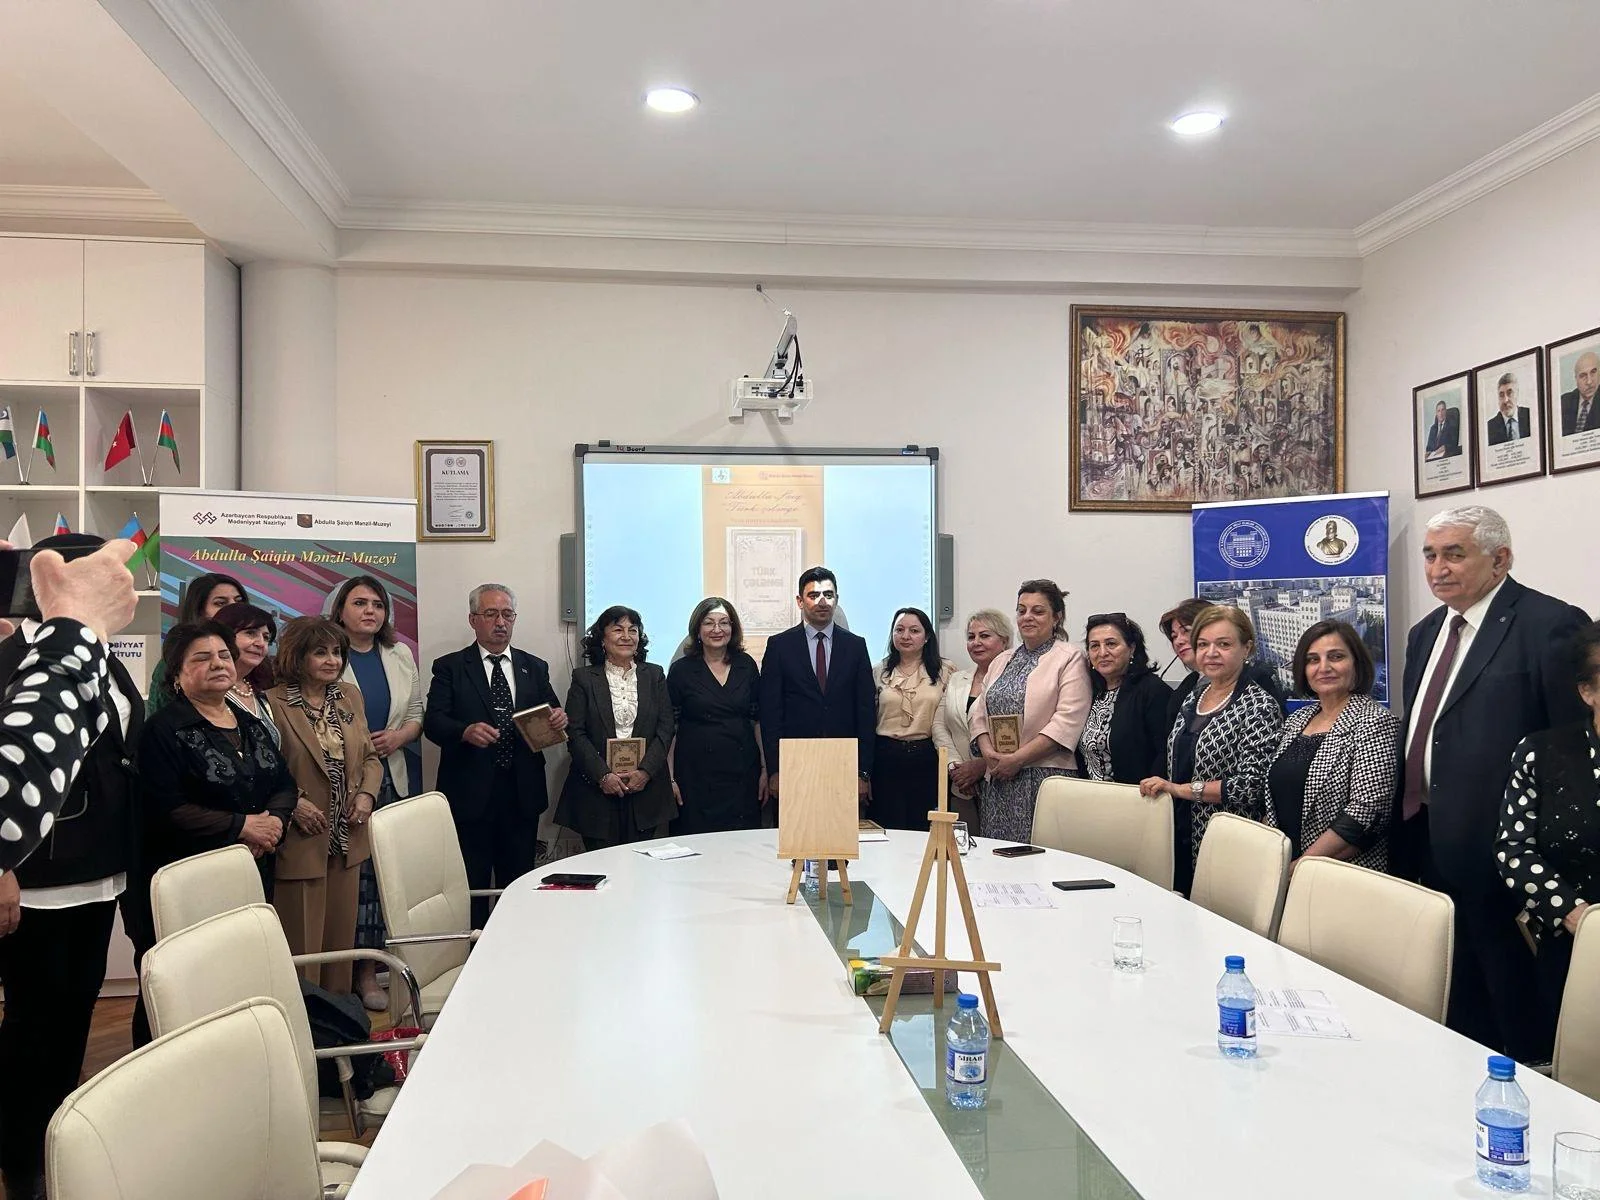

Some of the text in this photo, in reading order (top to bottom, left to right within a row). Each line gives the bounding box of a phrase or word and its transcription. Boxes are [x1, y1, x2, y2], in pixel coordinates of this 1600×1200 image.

[188, 549, 398, 566] Abdulla Şaiqin Mənzil-Muzeyi
